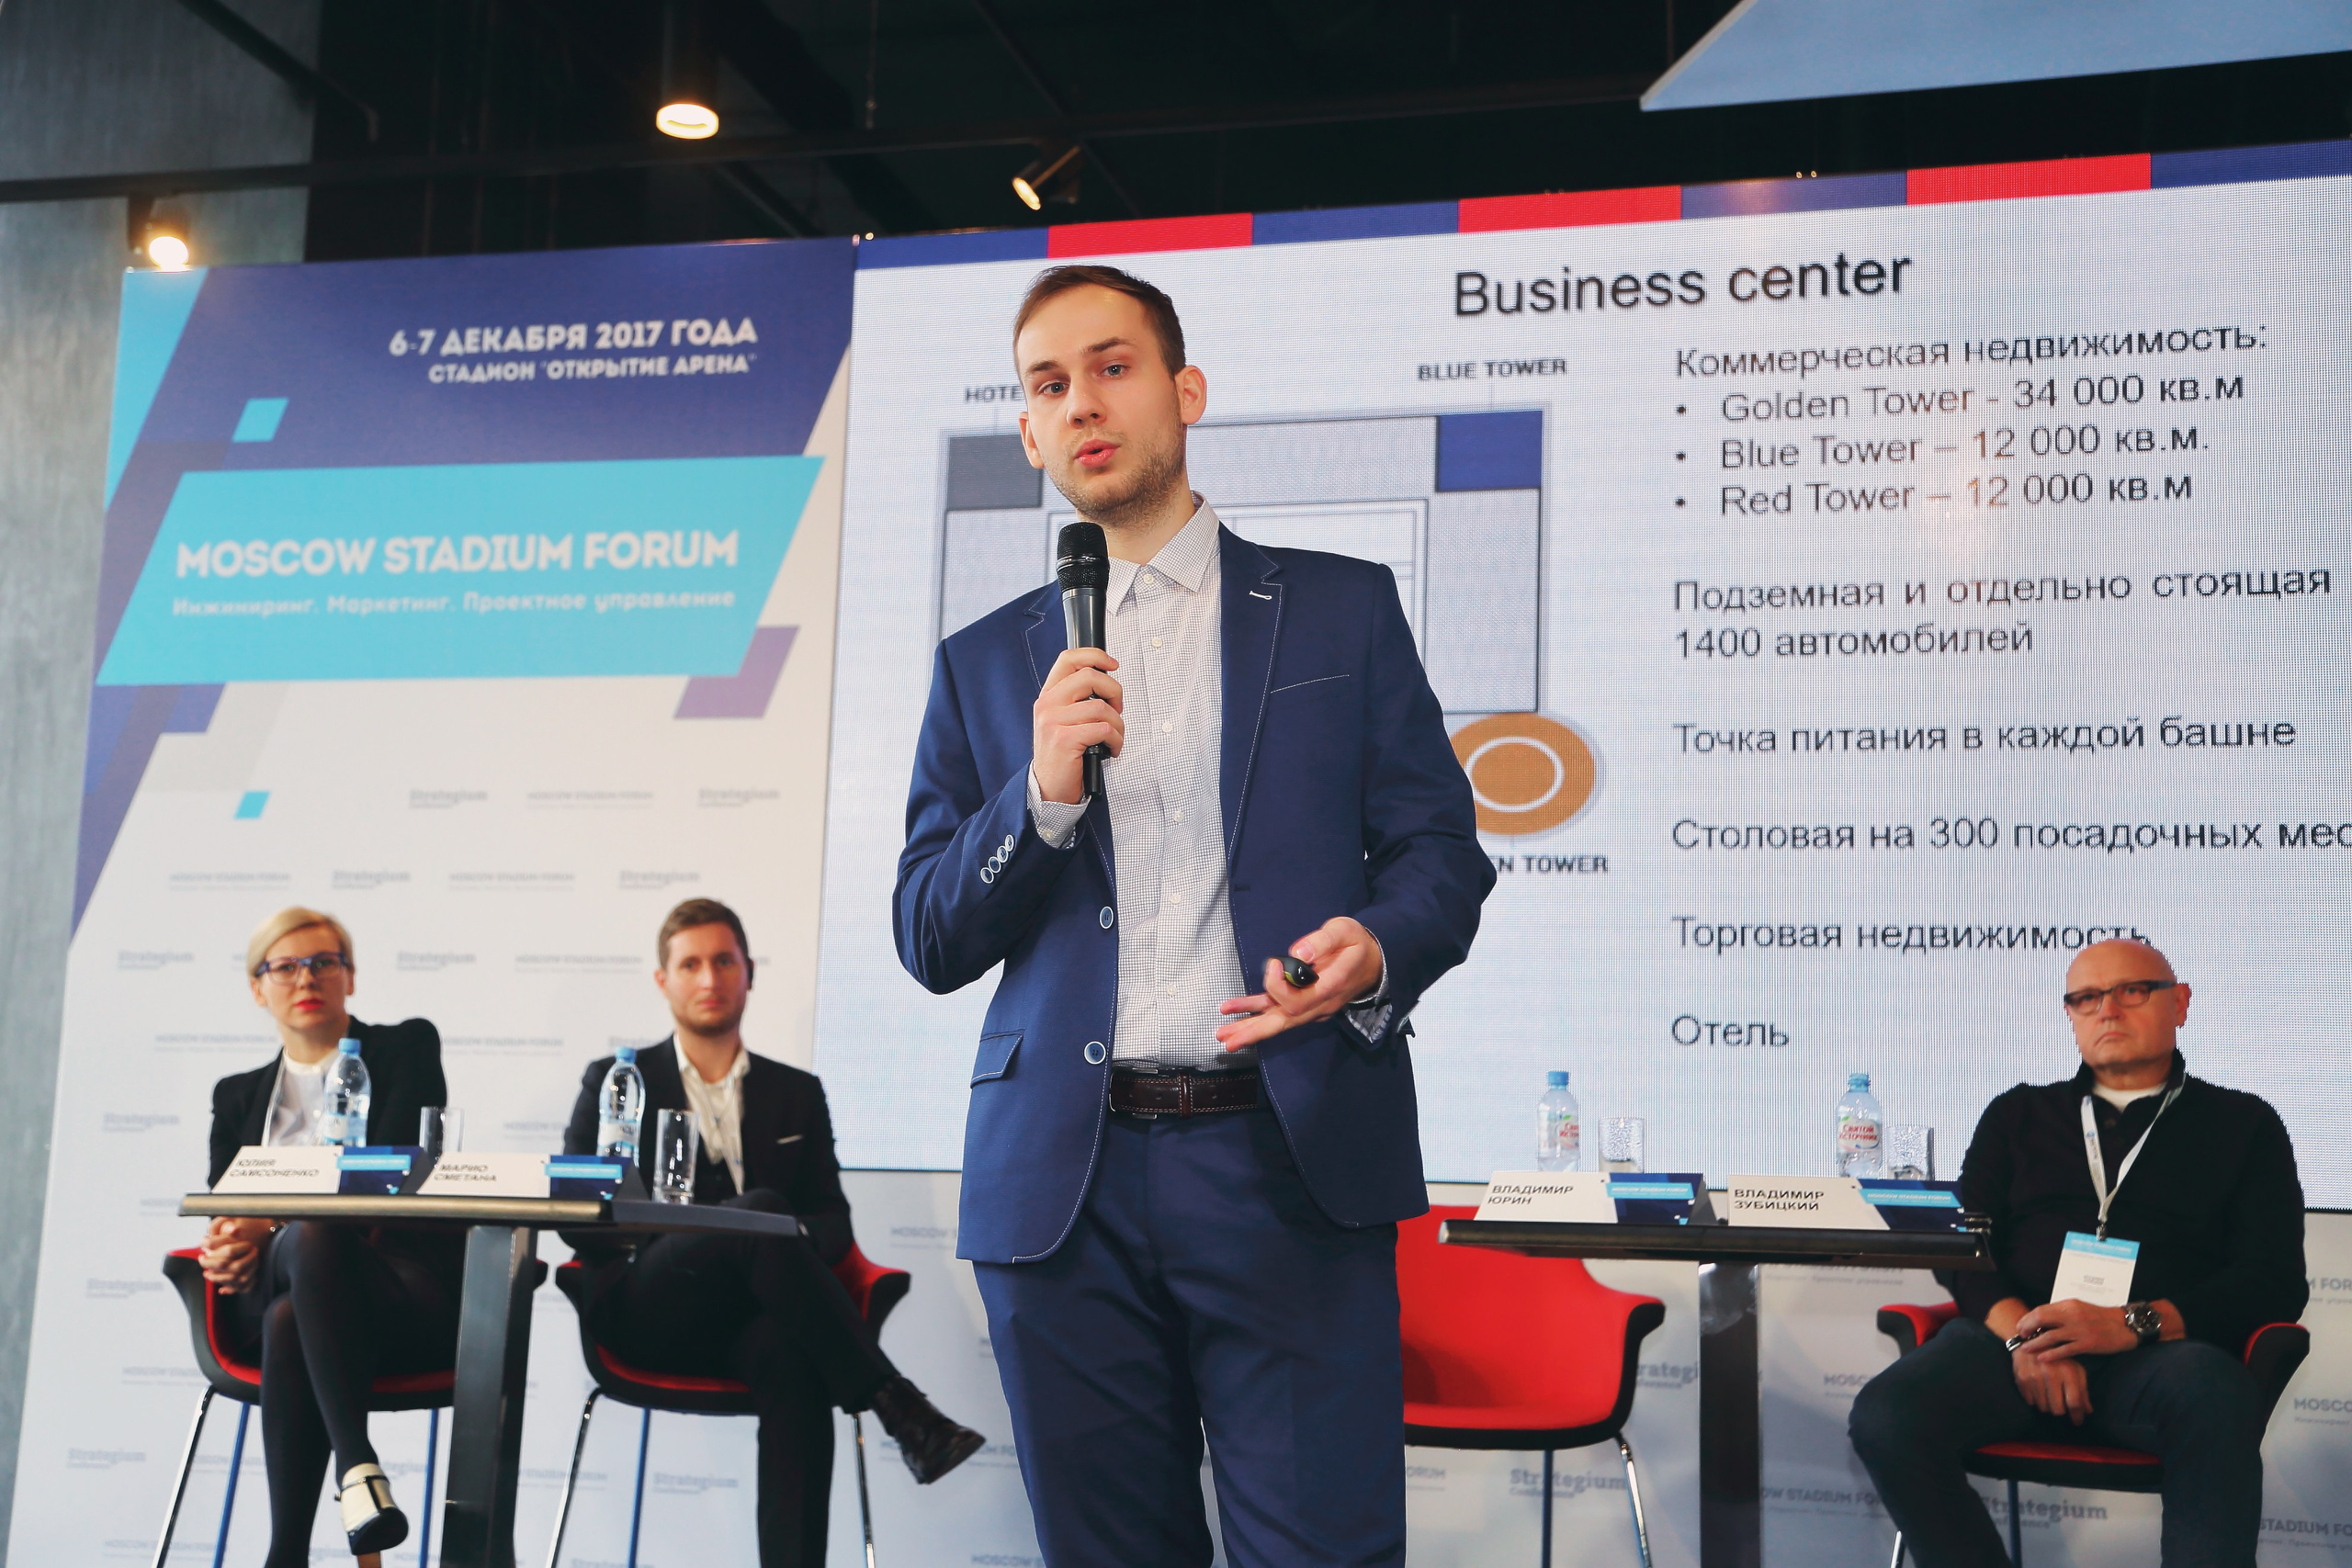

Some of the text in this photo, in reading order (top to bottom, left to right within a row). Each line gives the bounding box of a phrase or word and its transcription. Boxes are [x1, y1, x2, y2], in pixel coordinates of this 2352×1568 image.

[1454, 253, 1912, 316] Business center
[389, 317, 760, 357] 6-7 ДЕКАБРЯ 2017 ГОДА
[1677, 325, 2267, 379] Коммерческая недвижимость:
[428, 362, 537, 385] СТАДИОН
[1418, 356, 1568, 381] BLUE TOWER
[965, 385, 1025, 403] HOTE
[1723, 390, 1849, 423] Golden
[1862, 386, 1975, 416] Tower
[2014, 378, 2057, 411] 34
[2074, 374, 2144, 406] 000
[2159, 375, 2245, 403] кв.м
[1722, 437, 1801, 469] Blue
[1812, 434, 1924, 466] Tower
[1973, 428, 2017, 459] 12
[2030, 424, 2101, 457] 000
[2116, 426, 2210, 454] кв.м.
[1722, 483, 1793, 516] Red
[1804, 479, 1917, 513] Tower
[1967, 475, 2010, 508] 12
[2023, 472, 2094, 506] 000
[2109, 474, 2194, 503] кв.м
[176, 529, 740, 580] MOSCOW STADIUM FORUM
[463, 591, 588, 615] Проектное
[594, 589, 737, 614] управление
[1675, 569, 2333, 615] Подземная и отдельно стоящая
[1676, 621, 2034, 660] 1400 автомобилей
[1672, 715, 2297, 755] Точка питания в каждой башне
[1672, 818, 1855, 850] Столовая
[1871, 824, 1916, 850] на
[1930, 816, 1999, 850] 300
[2015, 821, 2263, 854] посадочных
[1521, 854, 1609, 874] TOWER
[1671, 916, 1842, 956] Торговая
[1672, 1014, 1790, 1047] Отель
[1487, 1195, 1533, 1205] ЮРИН
[1491, 1185, 1575, 1196] ВЛАДИМИР
[1733, 1200, 1820, 1212] ЗУБИЦКИЙ
[1734, 1188, 1826, 1199] ВЛАДИМИР
[2294, 1397, 2352, 1413] MOSCO
